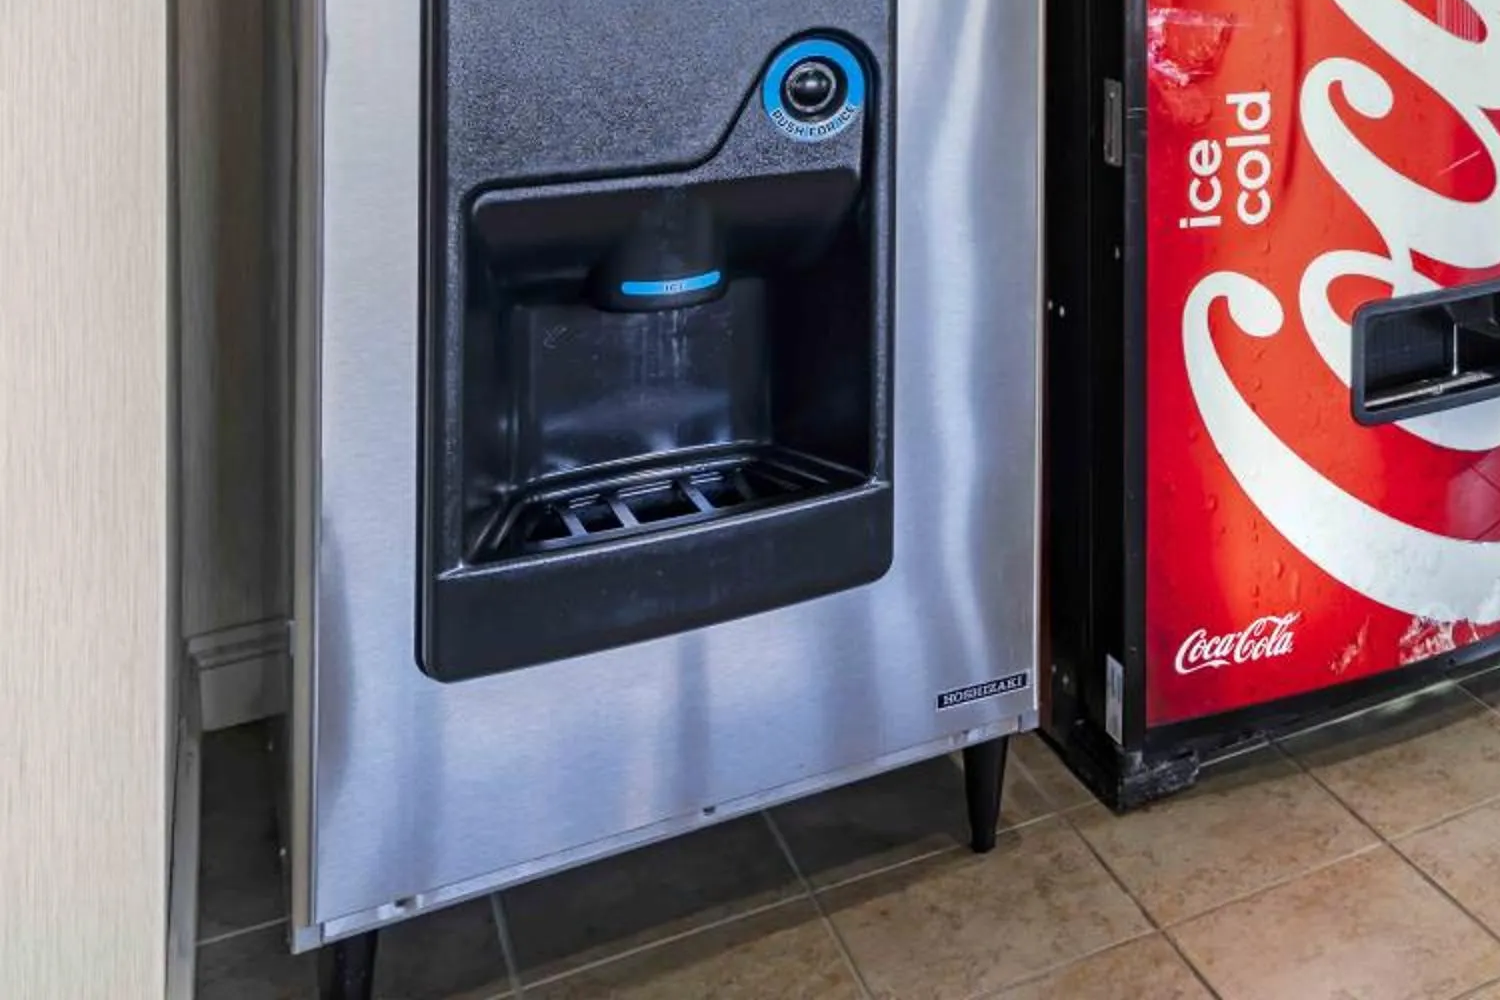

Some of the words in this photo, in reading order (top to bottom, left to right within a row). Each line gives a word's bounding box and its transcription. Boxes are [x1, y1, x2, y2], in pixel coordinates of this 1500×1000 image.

[771, 107, 805, 136] PUSH
[808, 121, 838, 137] FOR
[1178, 138, 1223, 229] ice
[1225, 90, 1272, 226] cold
[1174, 611, 1302, 675] Coca-Cola
[943, 675, 1023, 705] HOSHIZAKI
